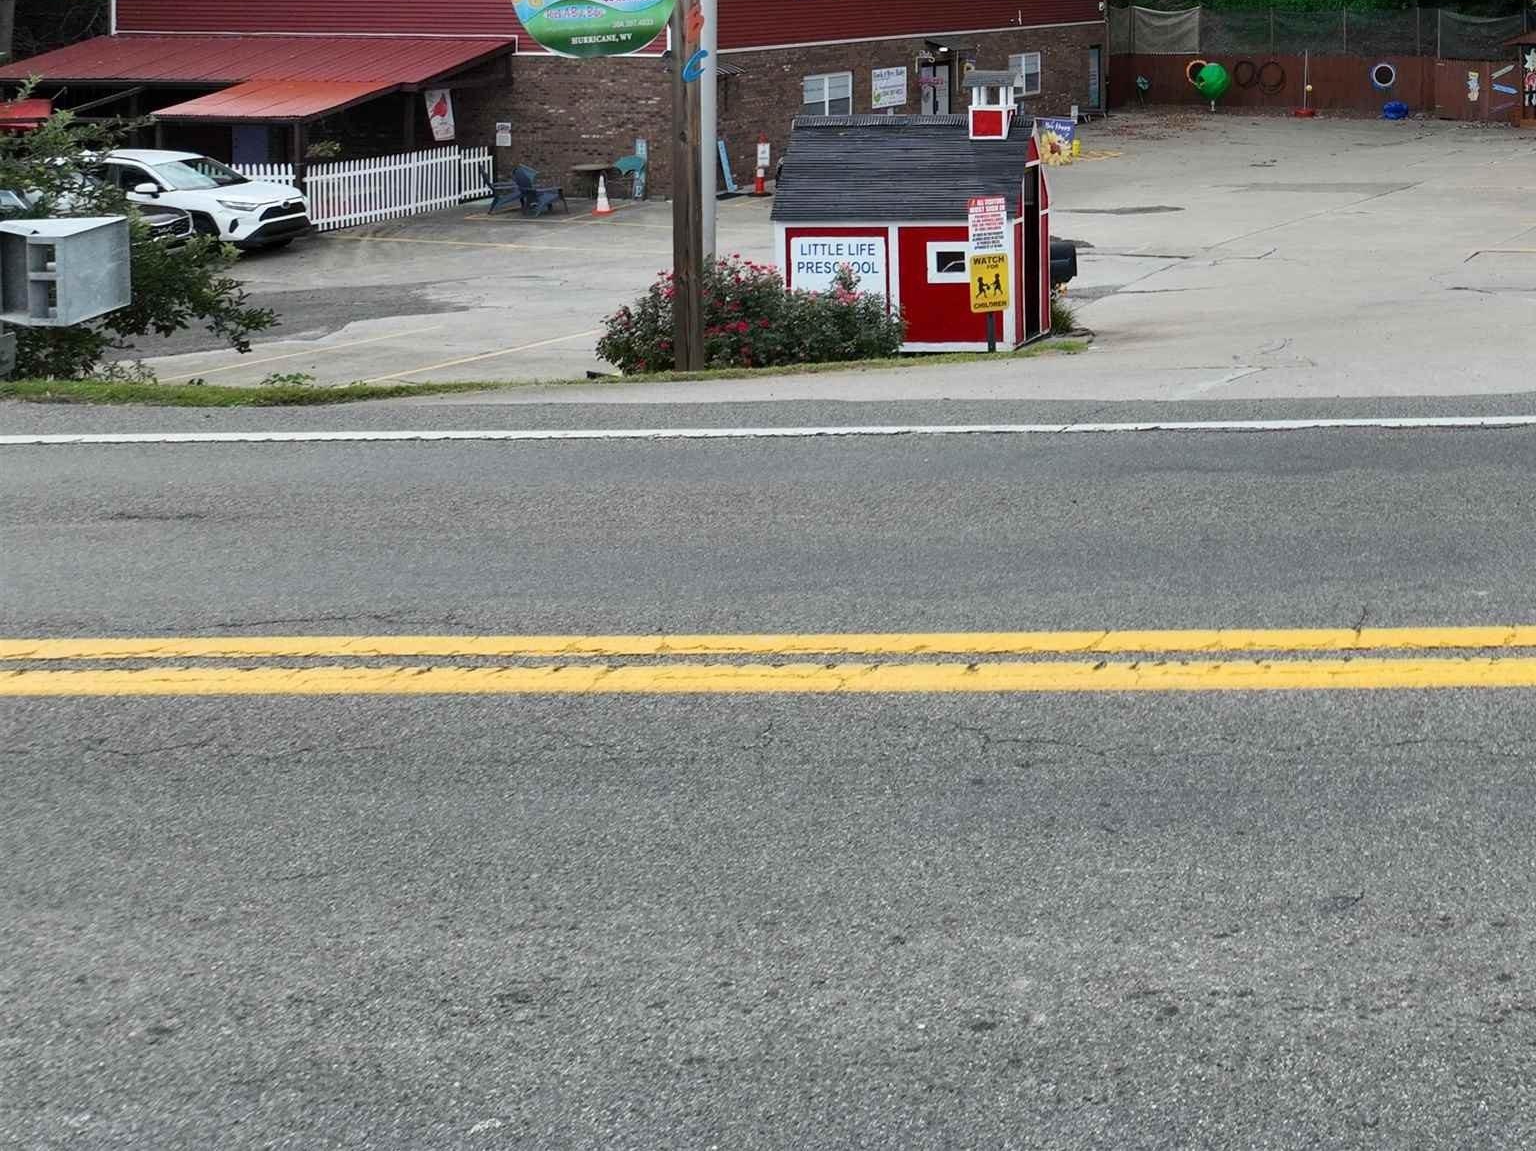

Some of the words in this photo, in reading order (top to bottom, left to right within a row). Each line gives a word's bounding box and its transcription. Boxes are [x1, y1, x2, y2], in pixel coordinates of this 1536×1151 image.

[571, 35, 618, 45] HURRICANE,
[620, 33, 632, 42] WV
[800, 243, 844, 256] LITTLE
[848, 243, 876, 256] LIFE
[973, 256, 1005, 265] WATCH
[797, 261, 879, 274] PRESCOOL
